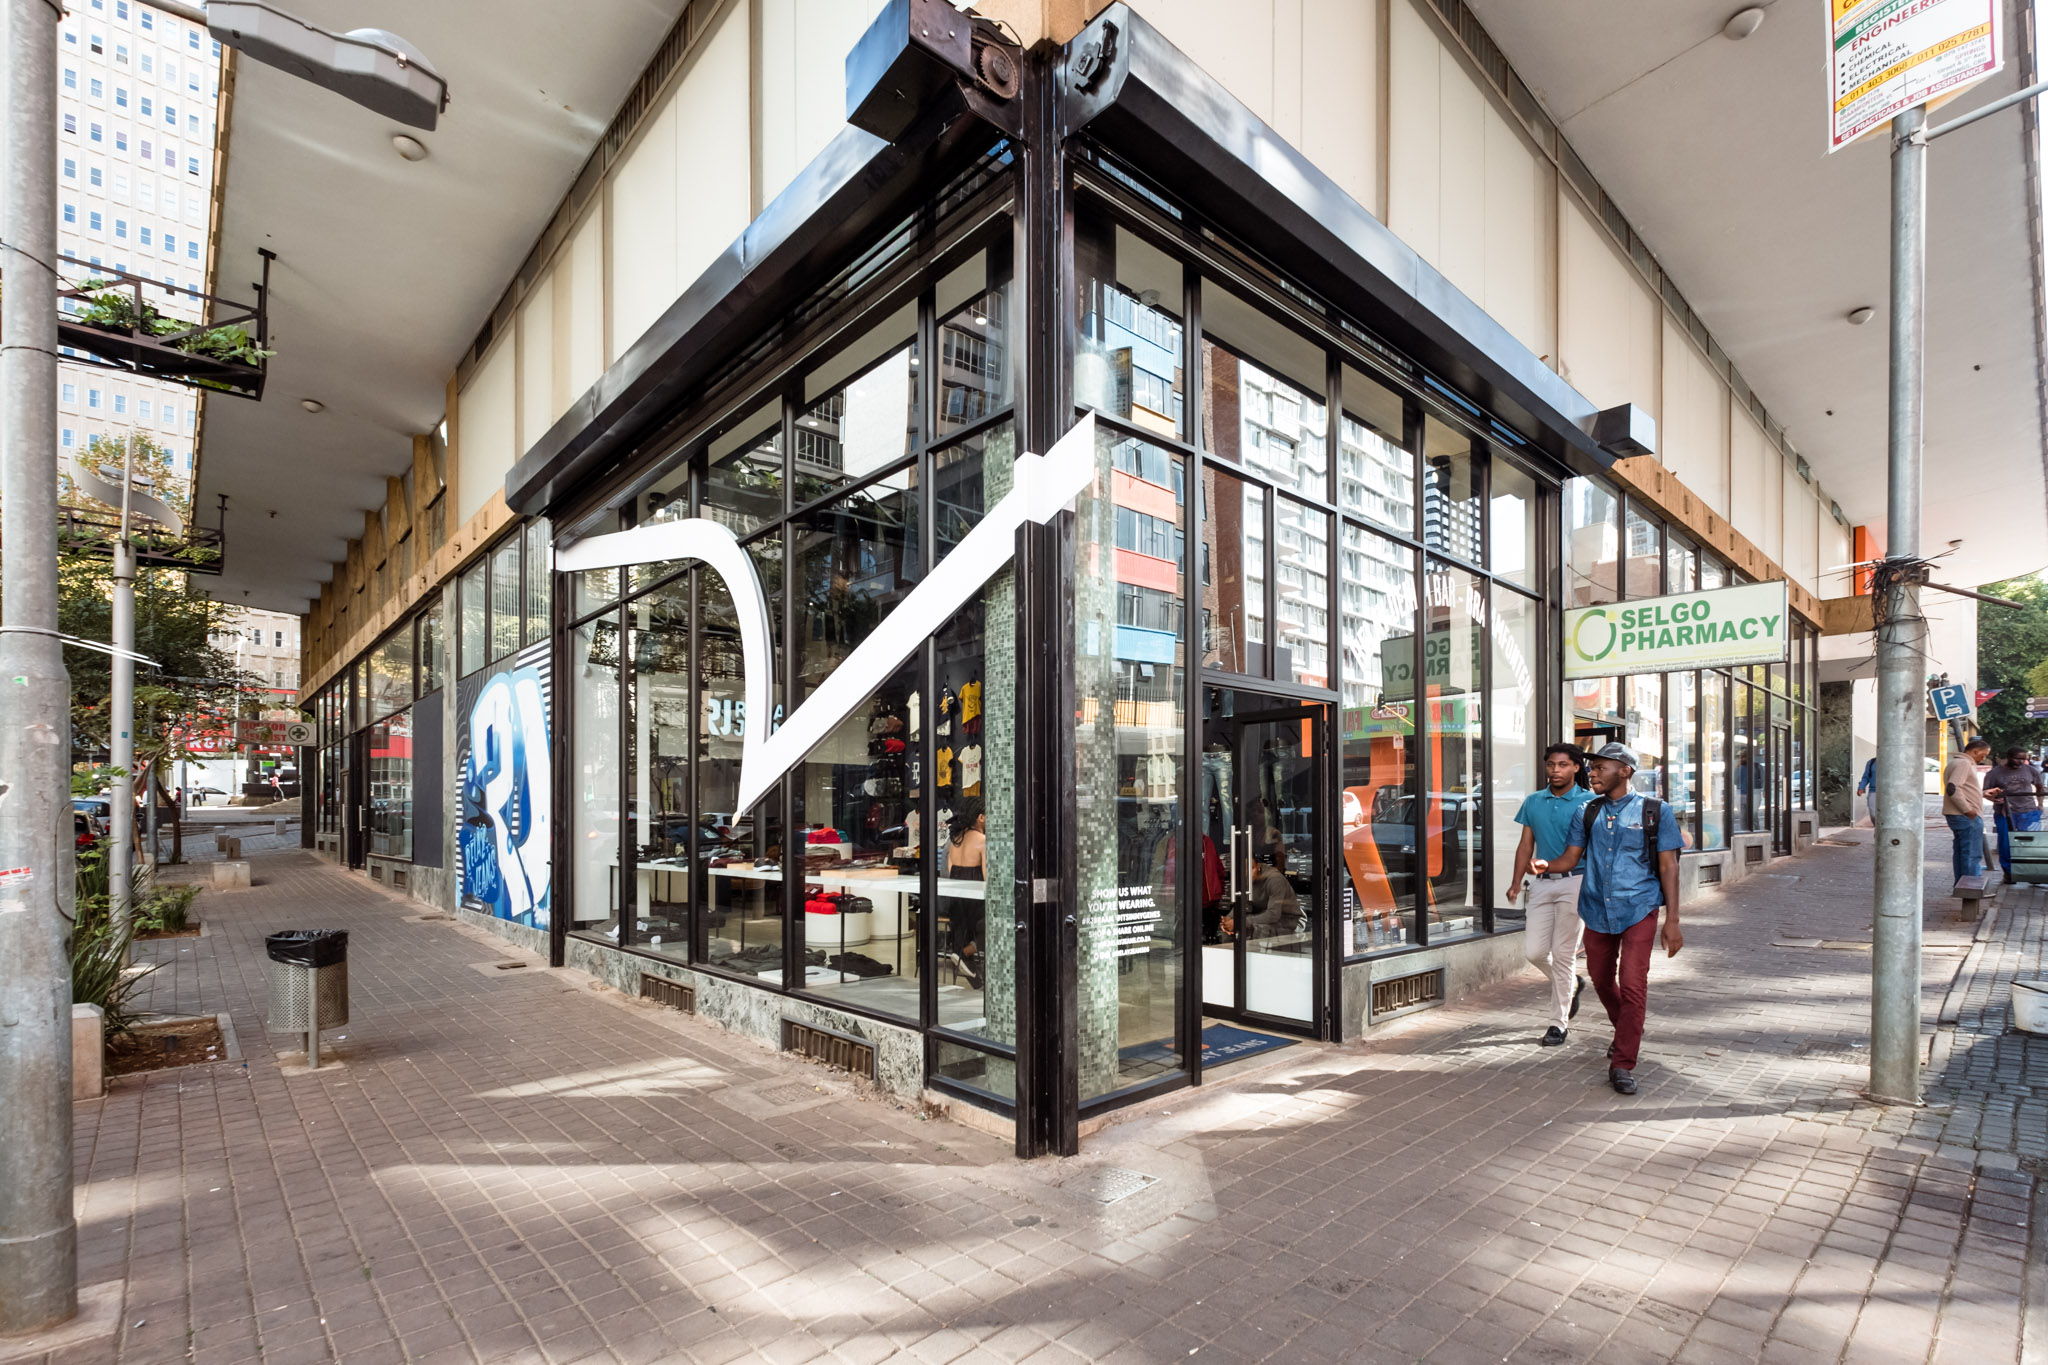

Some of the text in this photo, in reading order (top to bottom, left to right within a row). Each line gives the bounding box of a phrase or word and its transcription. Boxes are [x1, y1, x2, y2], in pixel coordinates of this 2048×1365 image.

[1852, 0, 1942, 51] ENGINEER
[1849, 44, 1872, 62] CIVIL
[1849, 41, 1892, 71] CHEMICAL
[1849, 42, 1908, 81] ELECTRICAL
[1850, 87, 1864, 100] 011
[1867, 76, 1883, 89] 403
[1917, 48, 1934, 62] 011
[1938, 38, 1957, 52] 025
[1960, 25, 1985, 42] 7781
[1849, 50, 1912, 89] MECHANICAL
[1841, 129, 1855, 141] GET
[1855, 102, 1901, 132] PRACTICALS
[1913, 88, 1929, 100] JOB
[1929, 64, 1985, 94] ASSISTANCE
[1433, 574, 1456, 608] BAR
[1621, 599, 1711, 630] SELGO
[1621, 614, 1781, 652] PHARMACY
[1940, 689, 1956, 705] P
[242, 732, 287, 742] DENIST
[1088, 898, 1156, 912] YOU'RE WEARING.
[1091, 885, 1152, 900] SHOW US WHAT
[1088, 929, 1106, 939] SHOP
[1113, 926, 1132, 936] SHARE
[1132, 924, 1154, 933] ONLINE
[1217, 1039, 1268, 1055] JEANS
